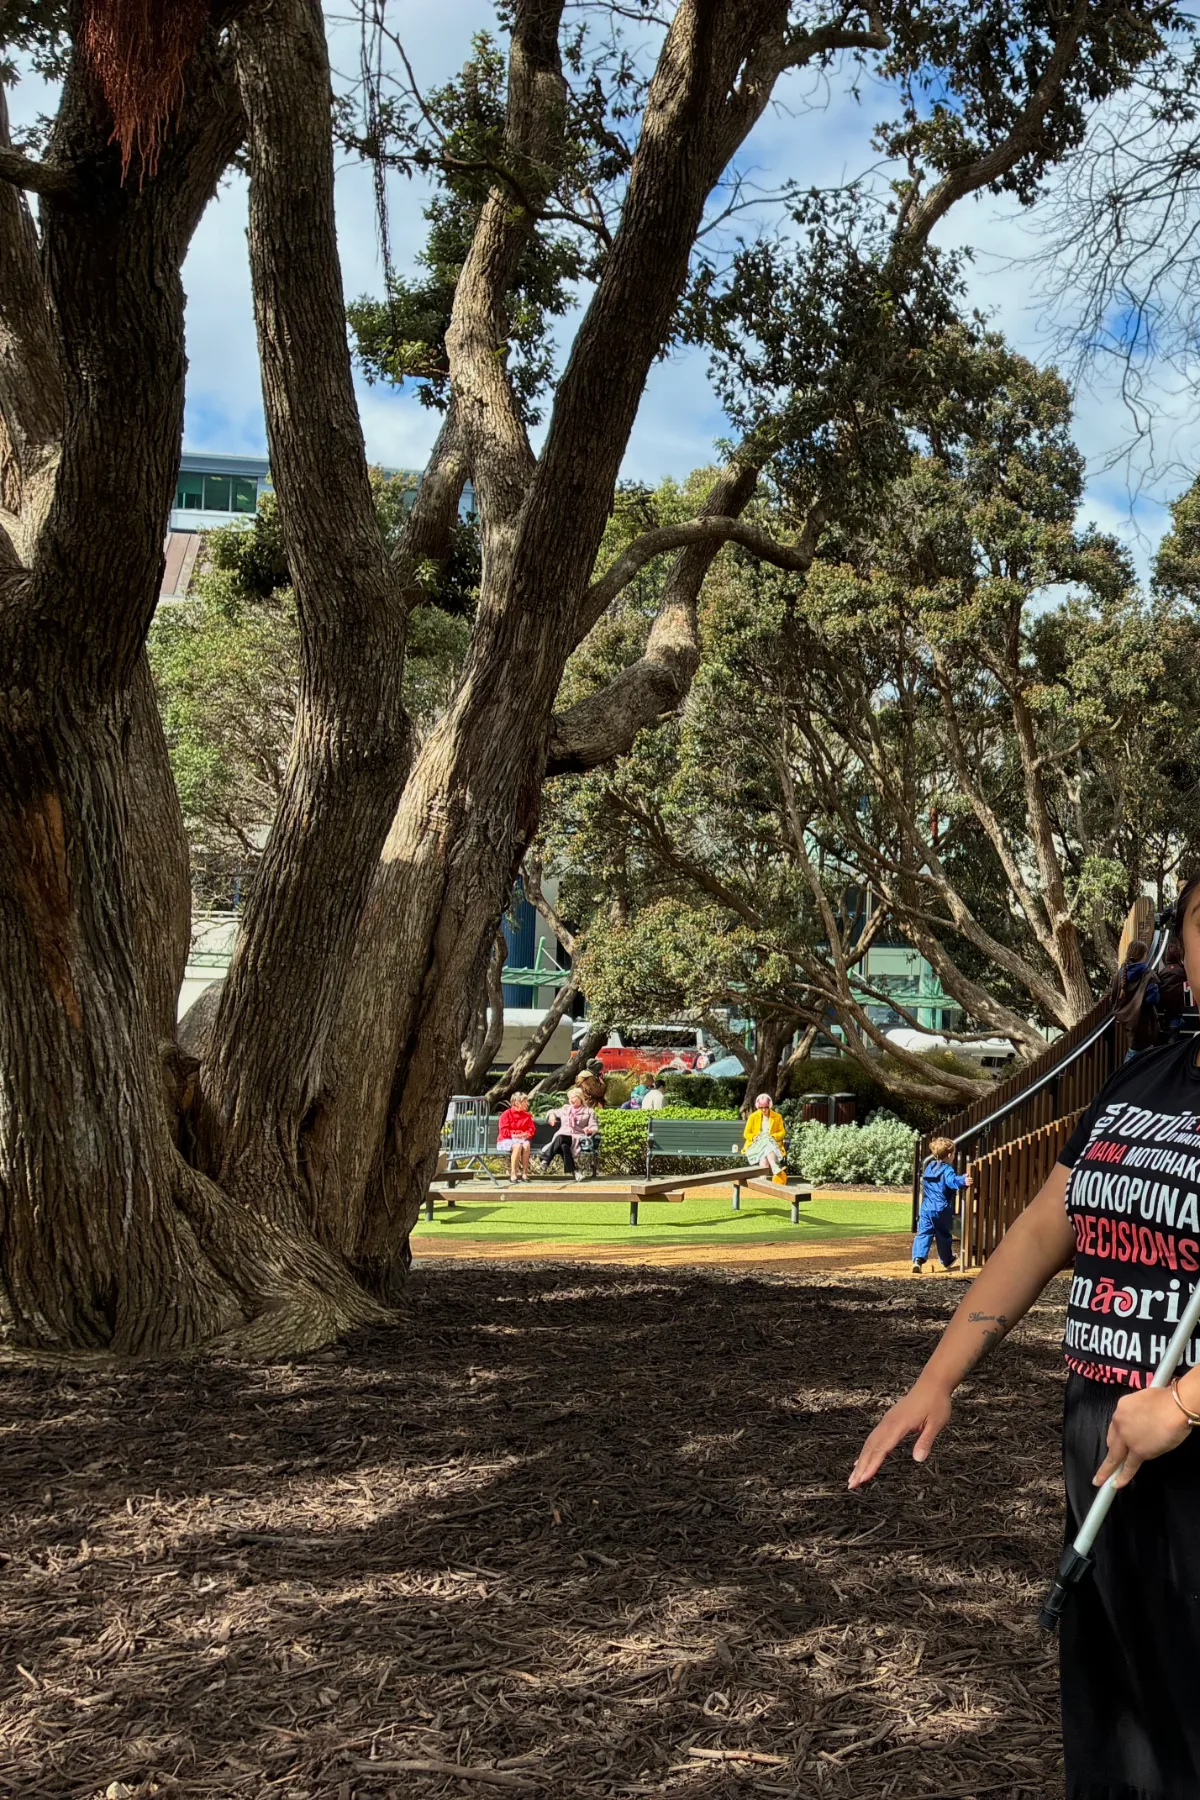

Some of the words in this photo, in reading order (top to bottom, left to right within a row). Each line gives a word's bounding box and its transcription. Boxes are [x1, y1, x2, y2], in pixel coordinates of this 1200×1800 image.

[1108, 1105, 1192, 1142] TOITŪ
[1084, 1141, 1128, 1164] MANA
[1070, 1170, 1200, 1234] MOKOPUNA
[1073, 1213, 1200, 1272] DECISIONS
[1069, 1275, 1181, 1323] māori
[1065, 1316, 1143, 1363] AOTEAROA
